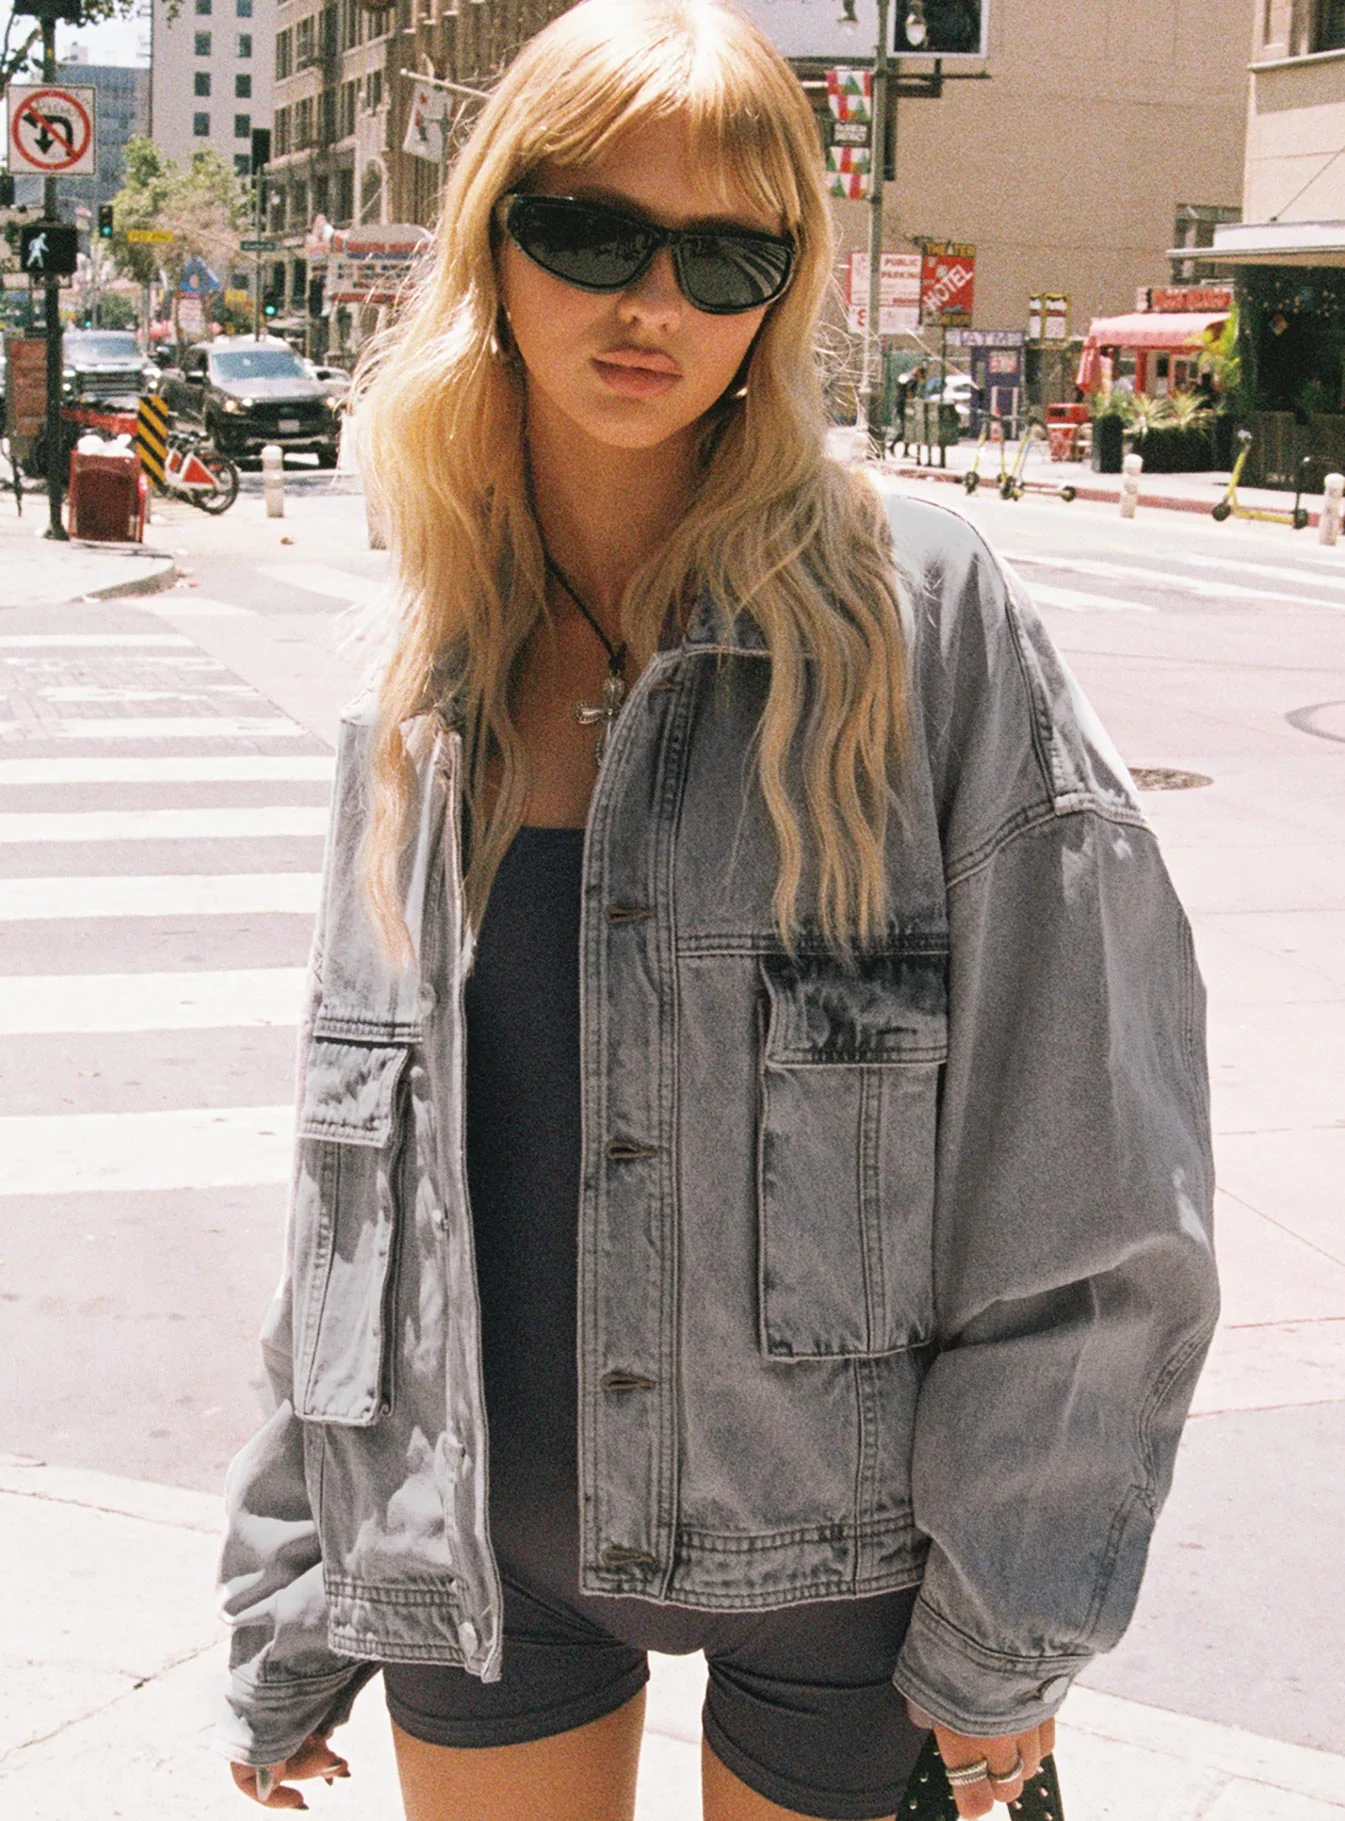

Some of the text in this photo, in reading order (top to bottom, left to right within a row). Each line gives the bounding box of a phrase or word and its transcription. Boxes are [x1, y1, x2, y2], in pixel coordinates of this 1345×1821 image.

[926, 243, 975, 255] THEATER
[884, 258, 918, 267] PUBLIC
[923, 264, 973, 310] HOTEL
